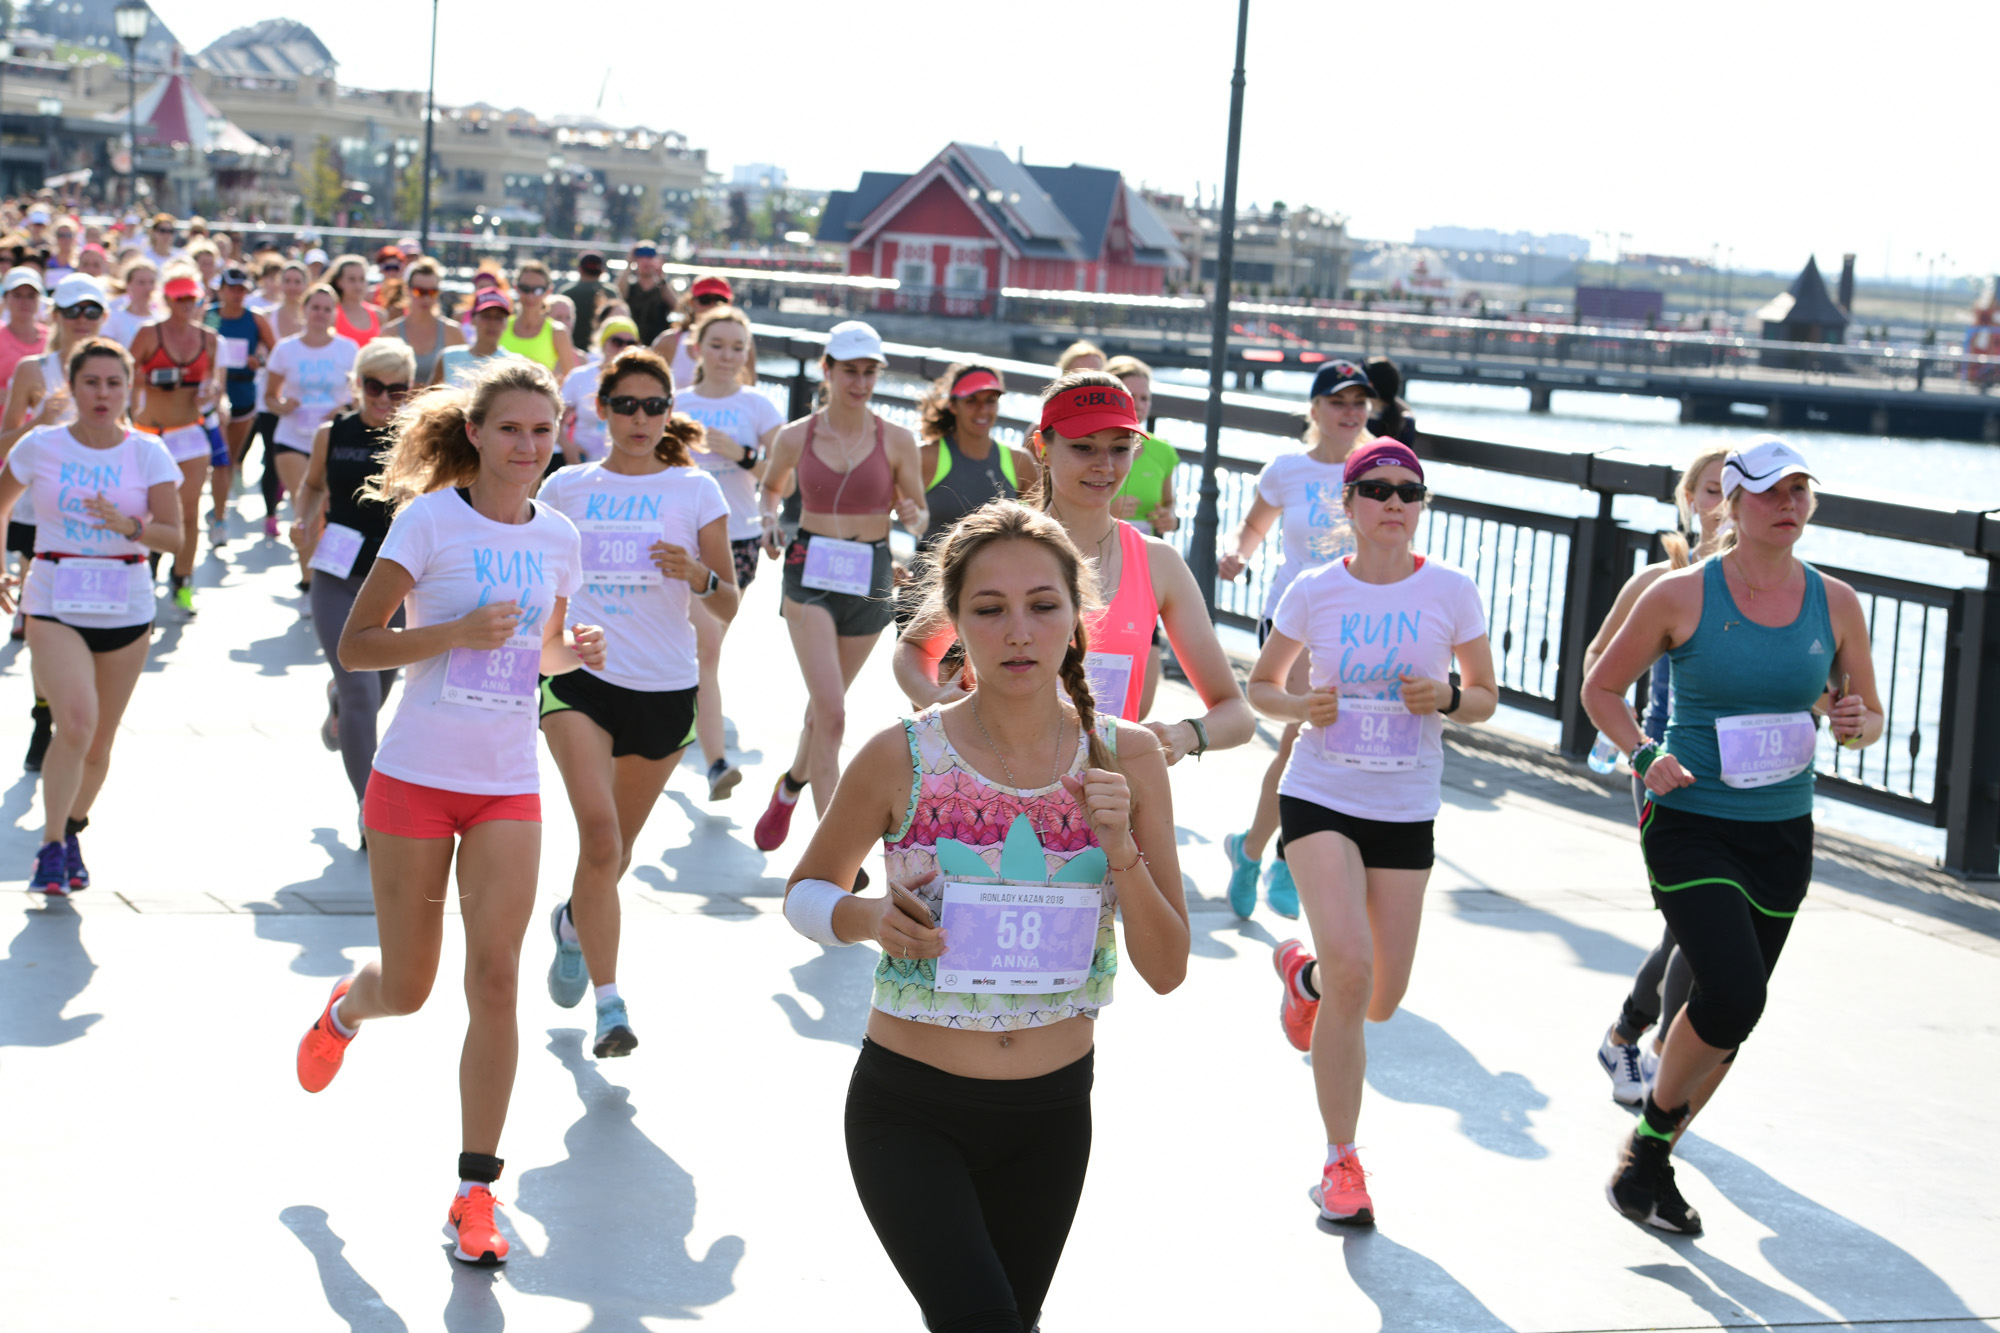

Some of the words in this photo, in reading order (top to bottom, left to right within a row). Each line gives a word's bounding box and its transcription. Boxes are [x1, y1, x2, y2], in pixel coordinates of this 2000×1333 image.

[60, 462, 122, 490] RUN
[586, 493, 662, 521] RUN
[599, 540, 637, 563] 208
[474, 548, 544, 588] RUN
[829, 556, 855, 576] 186
[81, 570, 101, 590] 21
[1340, 610, 1420, 648] RUN
[487, 649, 515, 678] 33
[481, 680, 511, 692] ANNA
[1360, 716, 1389, 742] 94
[1355, 743, 1391, 755] MARIA
[1755, 729, 1782, 757] 79
[1741, 757, 1796, 771] ELEONORA
[980, 893, 1016, 903] IRONLADY
[1018, 894, 1044, 903] KAZAN
[1045, 895, 1065, 904] 2018
[997, 911, 1042, 950] 58
[991, 954, 1040, 968] ANNA
